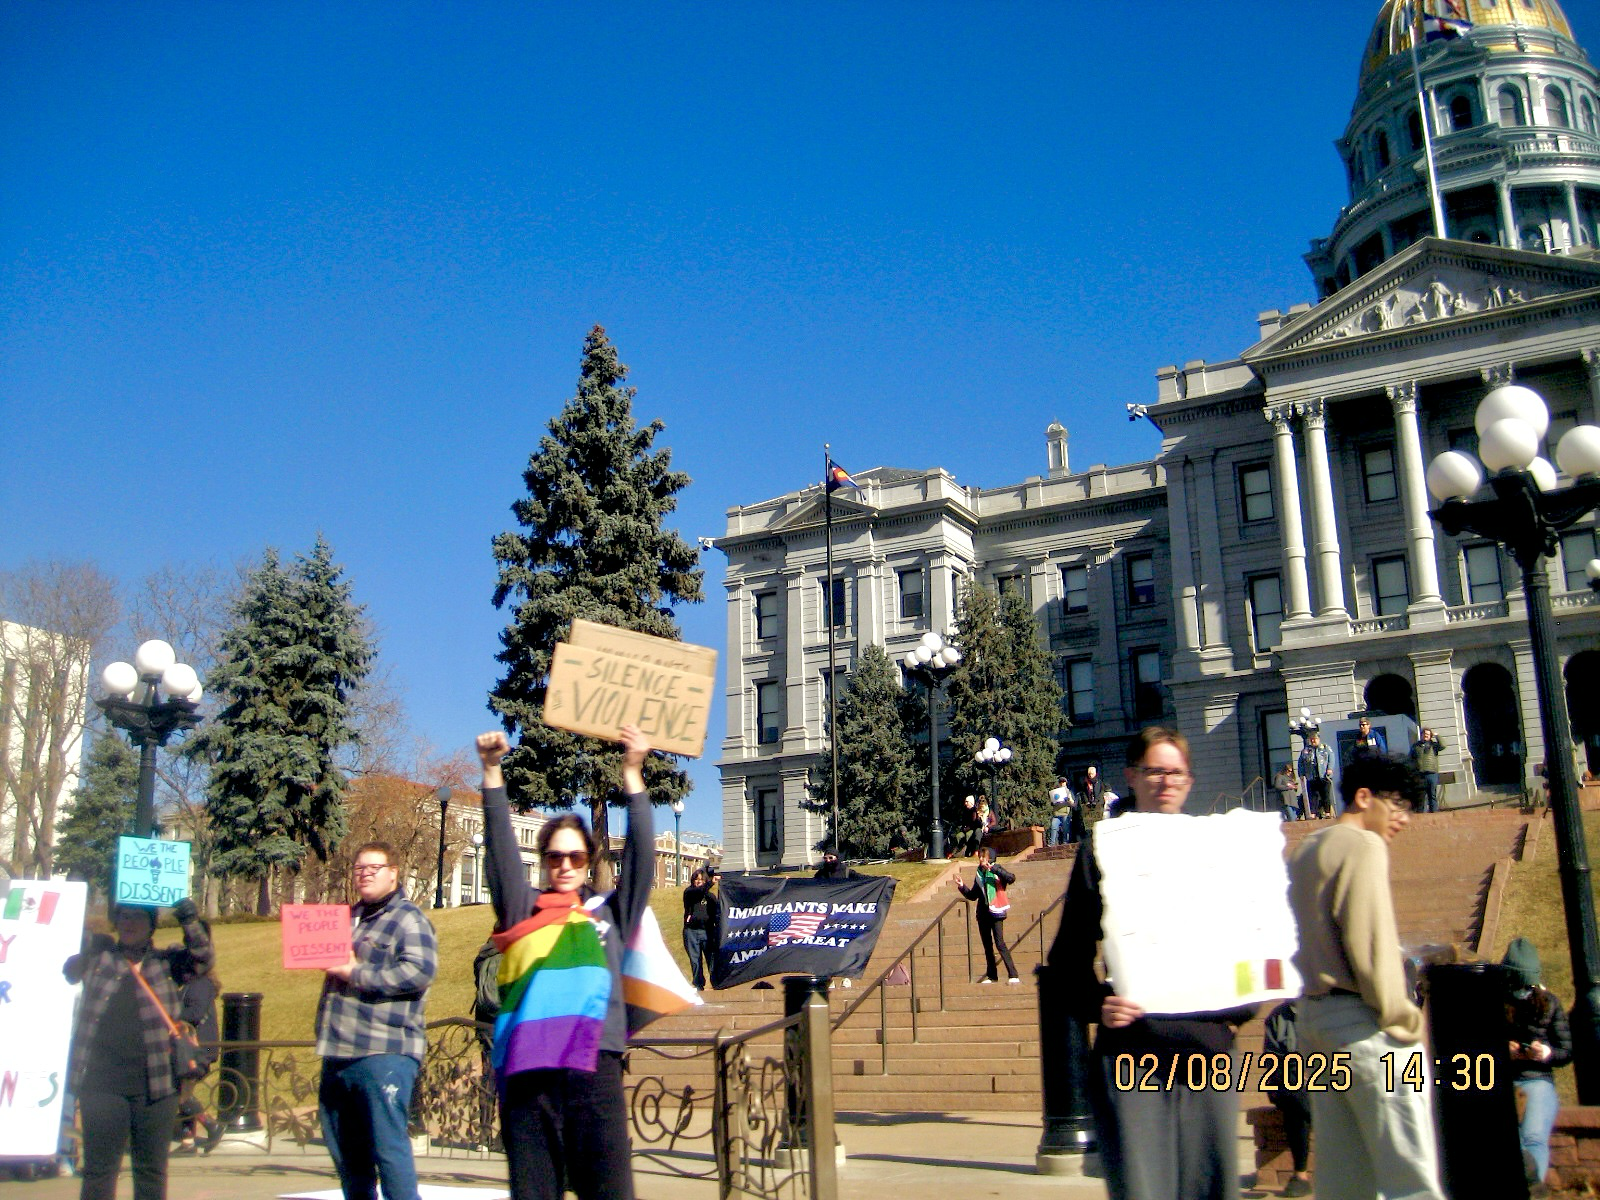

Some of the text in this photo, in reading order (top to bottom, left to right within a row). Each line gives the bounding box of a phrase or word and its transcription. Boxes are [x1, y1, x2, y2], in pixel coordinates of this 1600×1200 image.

[586, 656, 682, 699] SILENCE
[572, 680, 704, 742] VIOLENCE
[133, 841, 178, 854] WE THE
[119, 881, 185, 904] DISSENT
[289, 909, 340, 920] WE THE
[727, 902, 878, 919] IMMIGRANTS MAKE
[298, 920, 339, 935] PEOPLE
[290, 943, 348, 957] DISSENT
